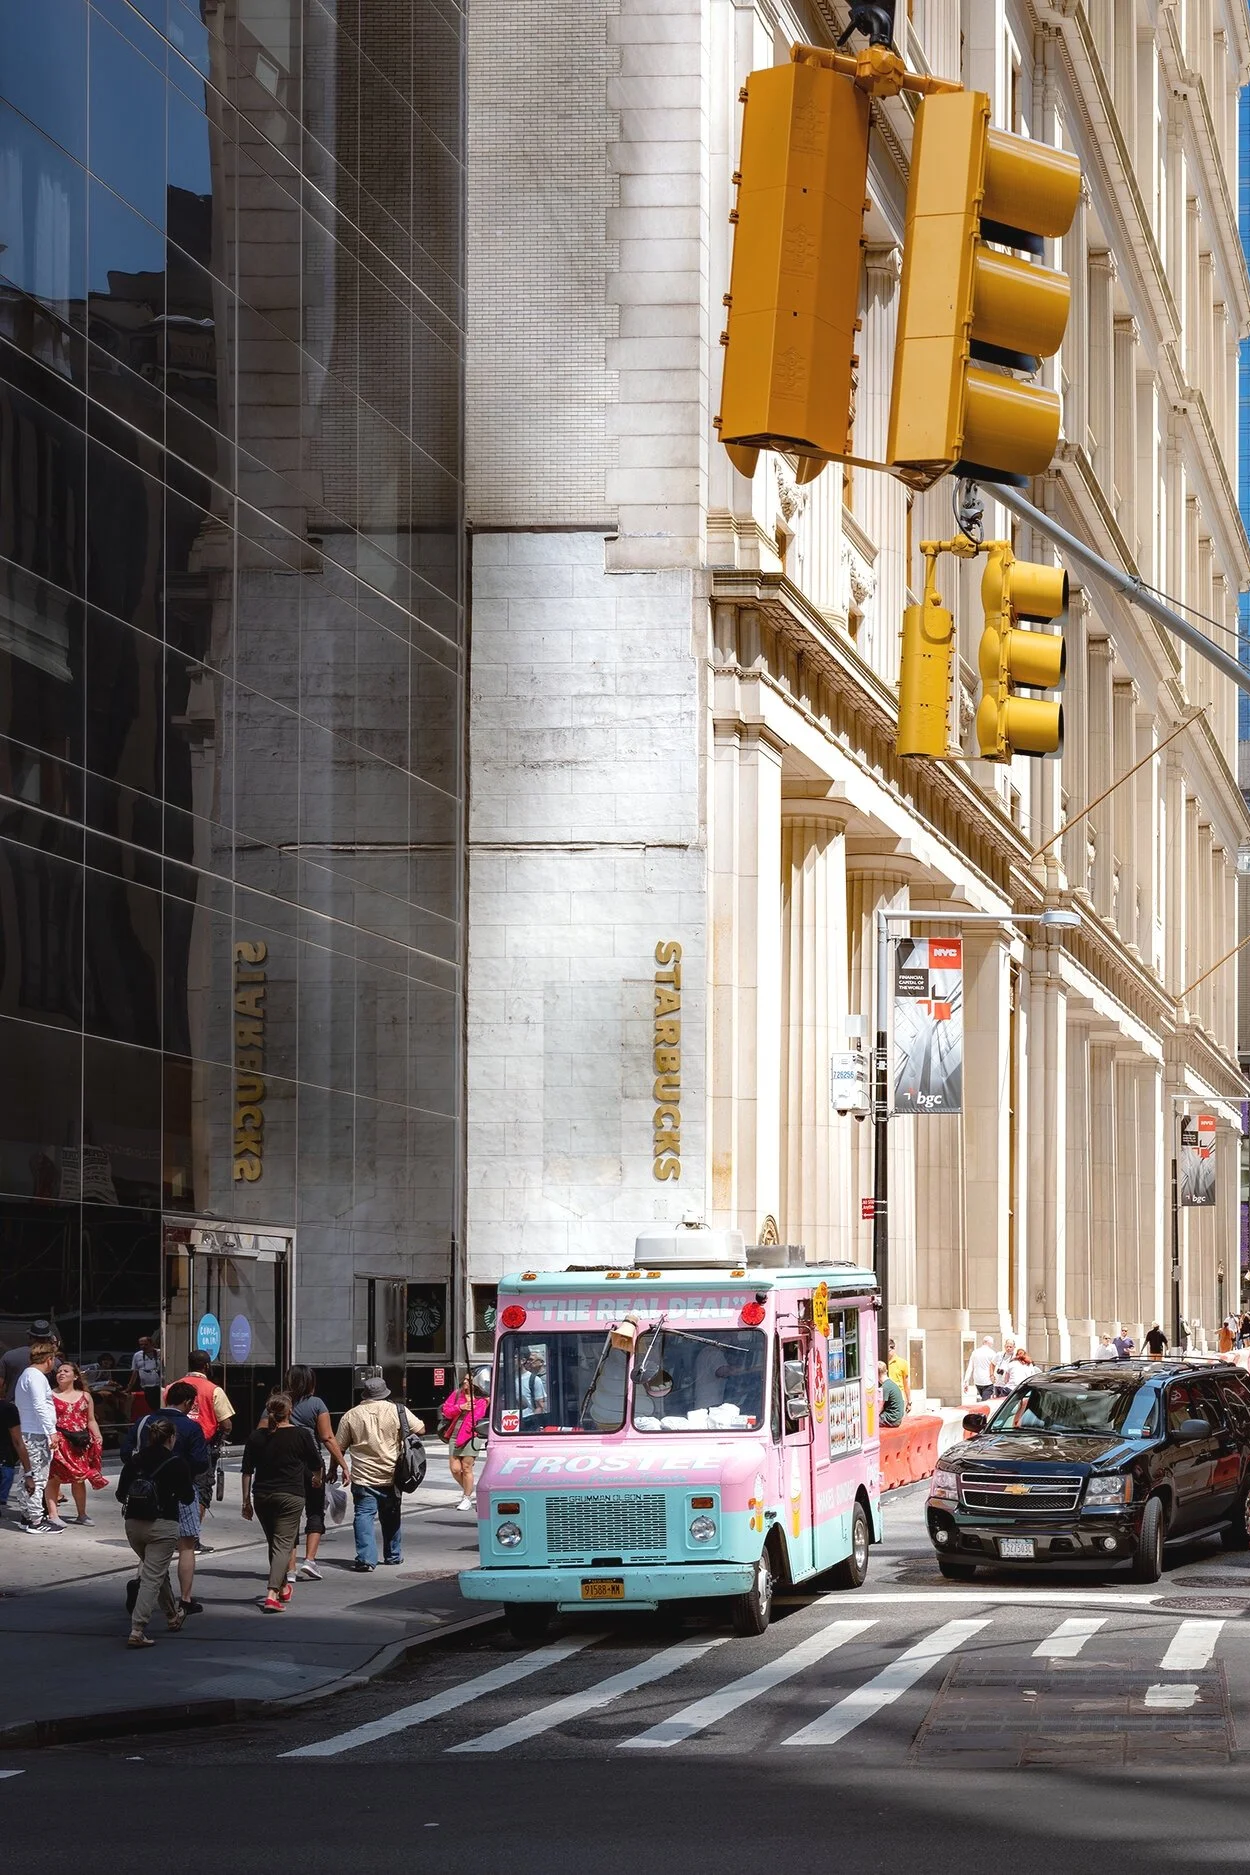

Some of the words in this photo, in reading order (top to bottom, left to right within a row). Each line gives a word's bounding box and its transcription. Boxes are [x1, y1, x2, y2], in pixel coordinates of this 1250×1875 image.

[933, 948, 957, 956] NYC
[654, 941, 681, 1181] STARBUCKS
[917, 1091, 942, 1108] bgc
[1192, 1194, 1206, 1204] bgc
[597, 1297, 664, 1321] REAL
[503, 1419, 519, 1427] NYC
[500, 1454, 721, 1475] FROSTEE
[612, 1493, 642, 1501] OLSON
